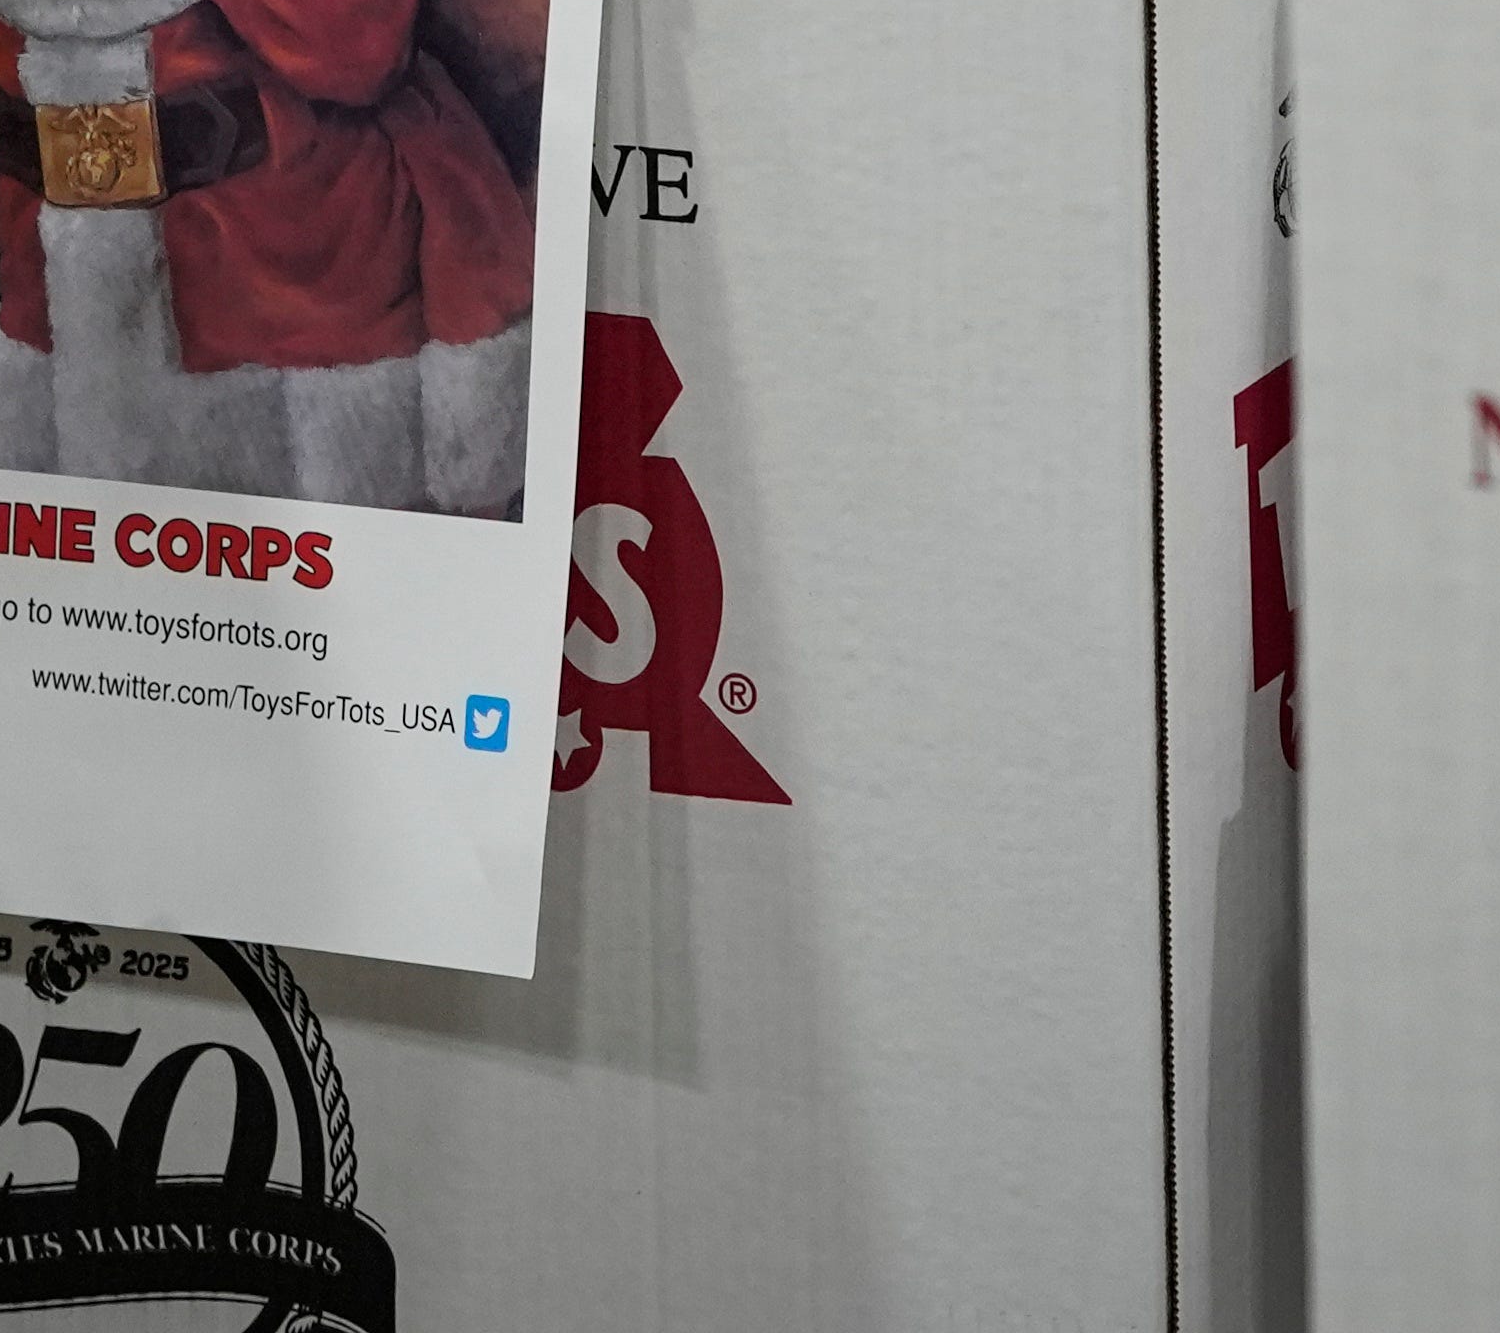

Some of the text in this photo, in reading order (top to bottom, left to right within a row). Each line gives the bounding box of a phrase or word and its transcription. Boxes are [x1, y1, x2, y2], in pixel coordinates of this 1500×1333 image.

[114, 513, 334, 591] CORPS
[27, 597, 53, 625] to
[61, 601, 330, 662] www.toysfortots.org
[31, 664, 457, 737] www.twitter.com/ToysForTots_USA
[120, 949, 190, 981] 2025
[74, 1223, 217, 1259] MARINE
[228, 1227, 342, 1275] CORPS
